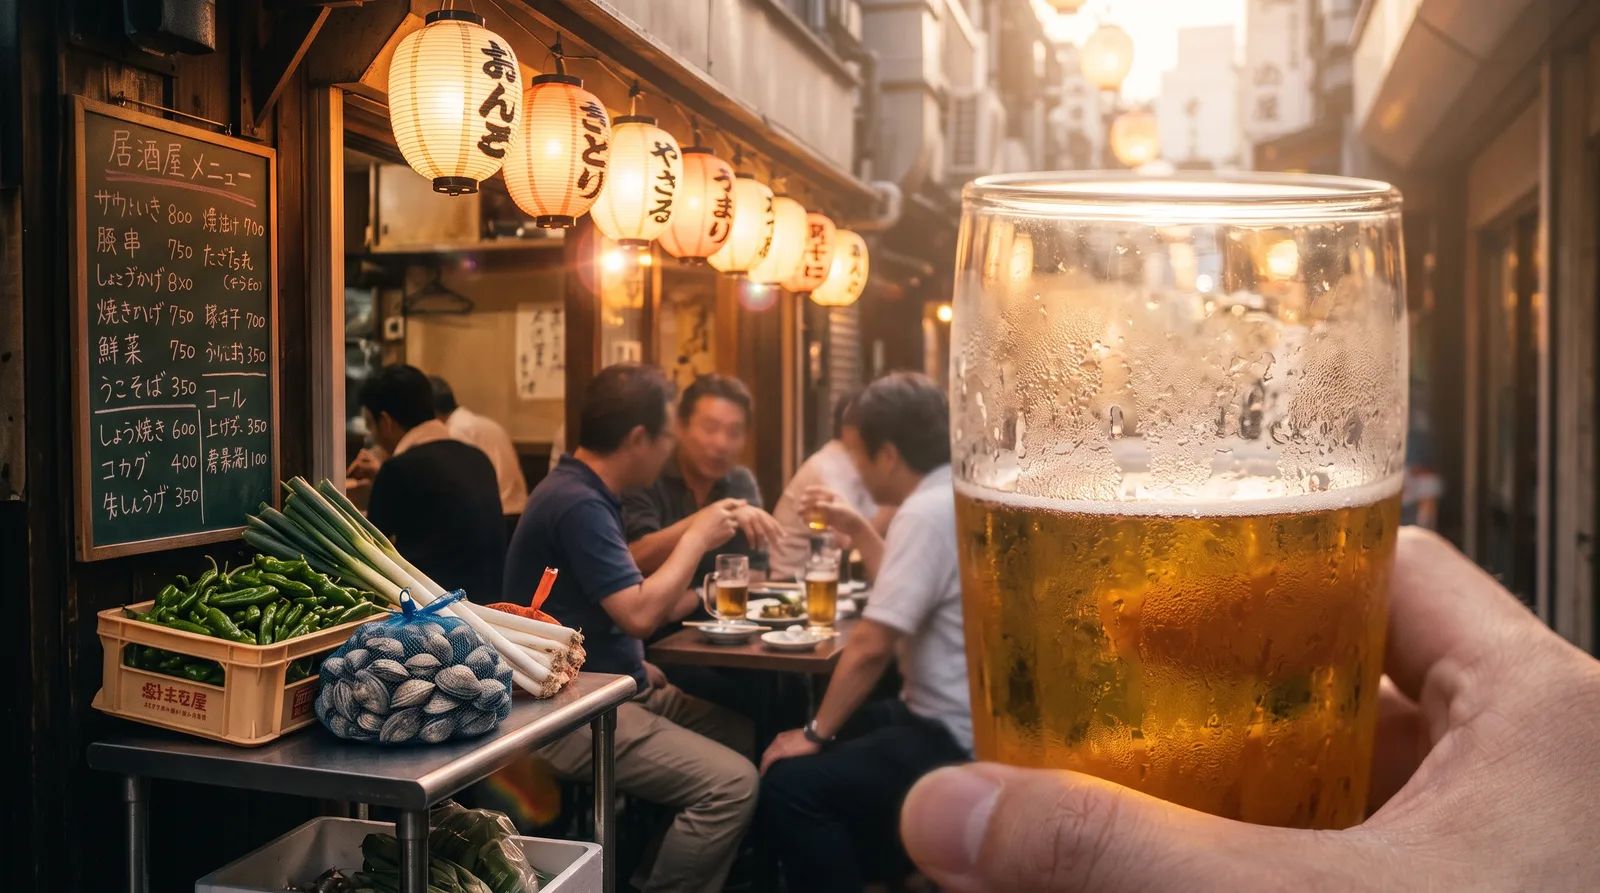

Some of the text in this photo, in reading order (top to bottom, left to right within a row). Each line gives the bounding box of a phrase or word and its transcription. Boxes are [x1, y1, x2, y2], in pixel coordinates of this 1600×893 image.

[108, 130, 252, 187] 居酒屋メニュー
[168, 203, 192, 225] 800
[244, 217, 265, 237] 700
[168, 239, 193, 260] 750
[169, 305, 194, 326] 750
[246, 312, 266, 329] 700
[169, 340, 195, 361] 750
[247, 346, 267, 364] 350
[100, 370, 197, 403] うこそば 350
[205, 388, 247, 408] コール
[101, 417, 196, 447] しょう焼き 600
[247, 418, 267, 436] 350
[101, 450, 197, 480] コカグ 400
[251, 451, 267, 467] 100
[175, 487, 199, 508] 350
